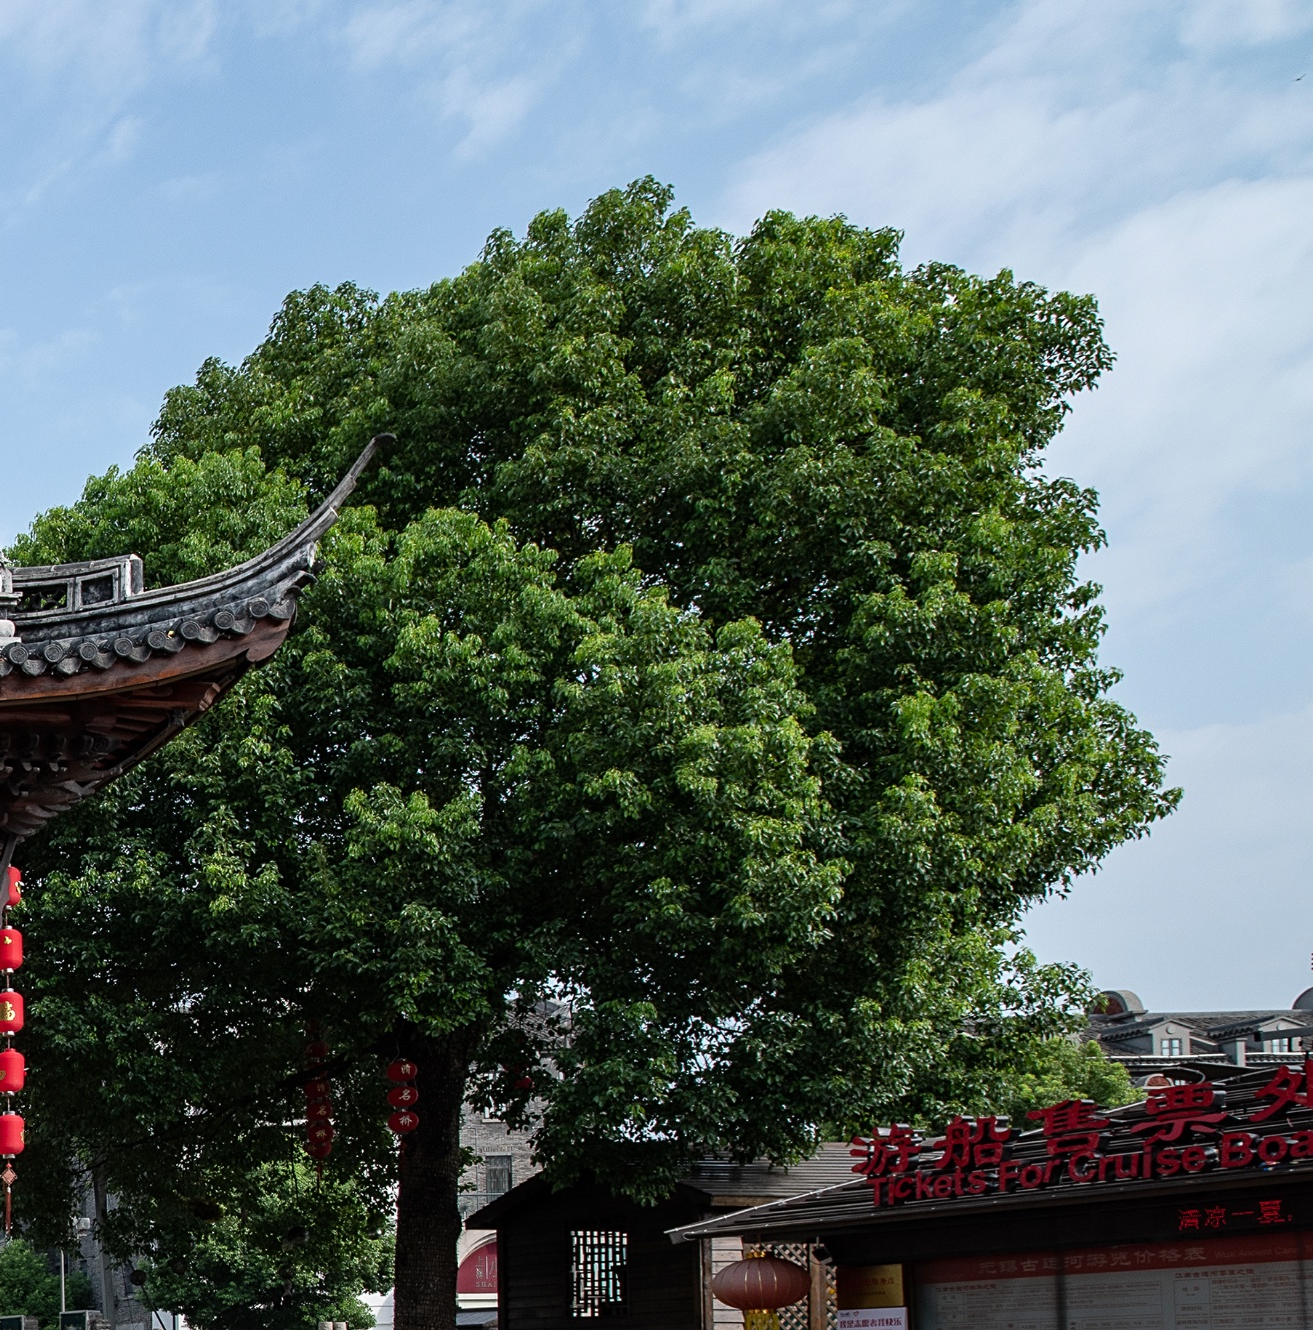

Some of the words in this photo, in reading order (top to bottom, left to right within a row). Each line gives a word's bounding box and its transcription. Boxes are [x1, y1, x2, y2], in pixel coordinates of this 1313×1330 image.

[850, 1059, 1313, 1175] 游船售票处
[867, 1167, 987, 1207] Tickets
[999, 1159, 1061, 1192] For
[1069, 1133, 1207, 1183] Cruise
[978, 1246, 1207, 1276] 无锡古运河游览价格表
[1214, 1250, 1236, 1258] Wuxi
[1239, 1247, 1271, 1257] Ancient
[839, 1318, 902, 1328] 我是志愿者我快乐
